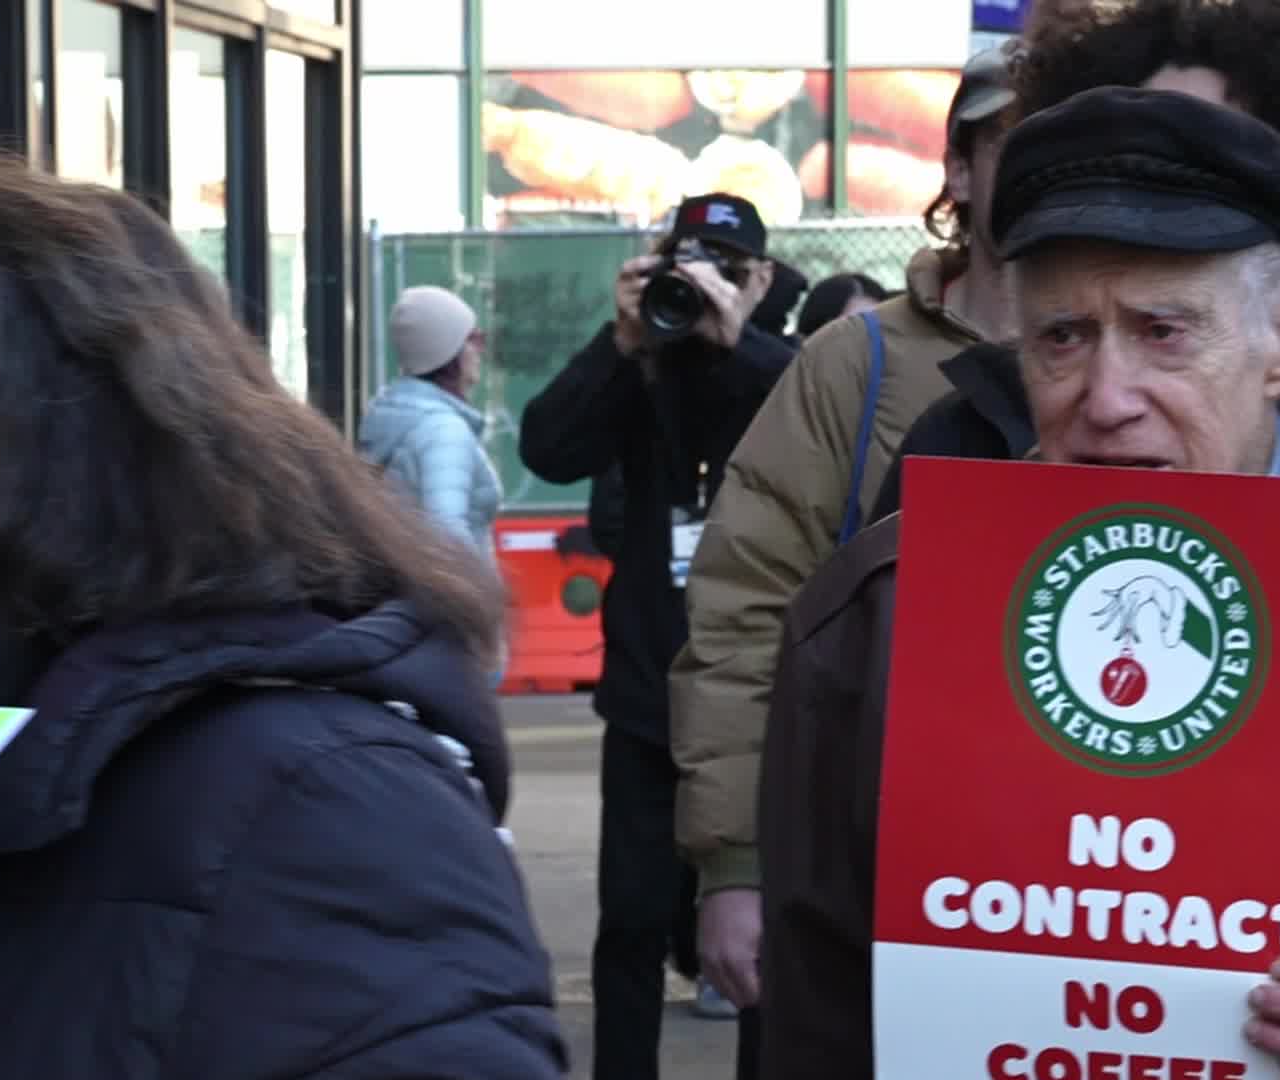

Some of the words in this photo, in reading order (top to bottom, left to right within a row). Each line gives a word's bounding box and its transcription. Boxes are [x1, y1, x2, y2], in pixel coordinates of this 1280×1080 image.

[1044, 523, 1241, 600] STARBUCKS
[1024, 612, 1133, 755] WORKERS
[1159, 627, 1250, 751] UNITED
[1068, 813, 1176, 872] NO
[1064, 980, 1165, 1034] NO
